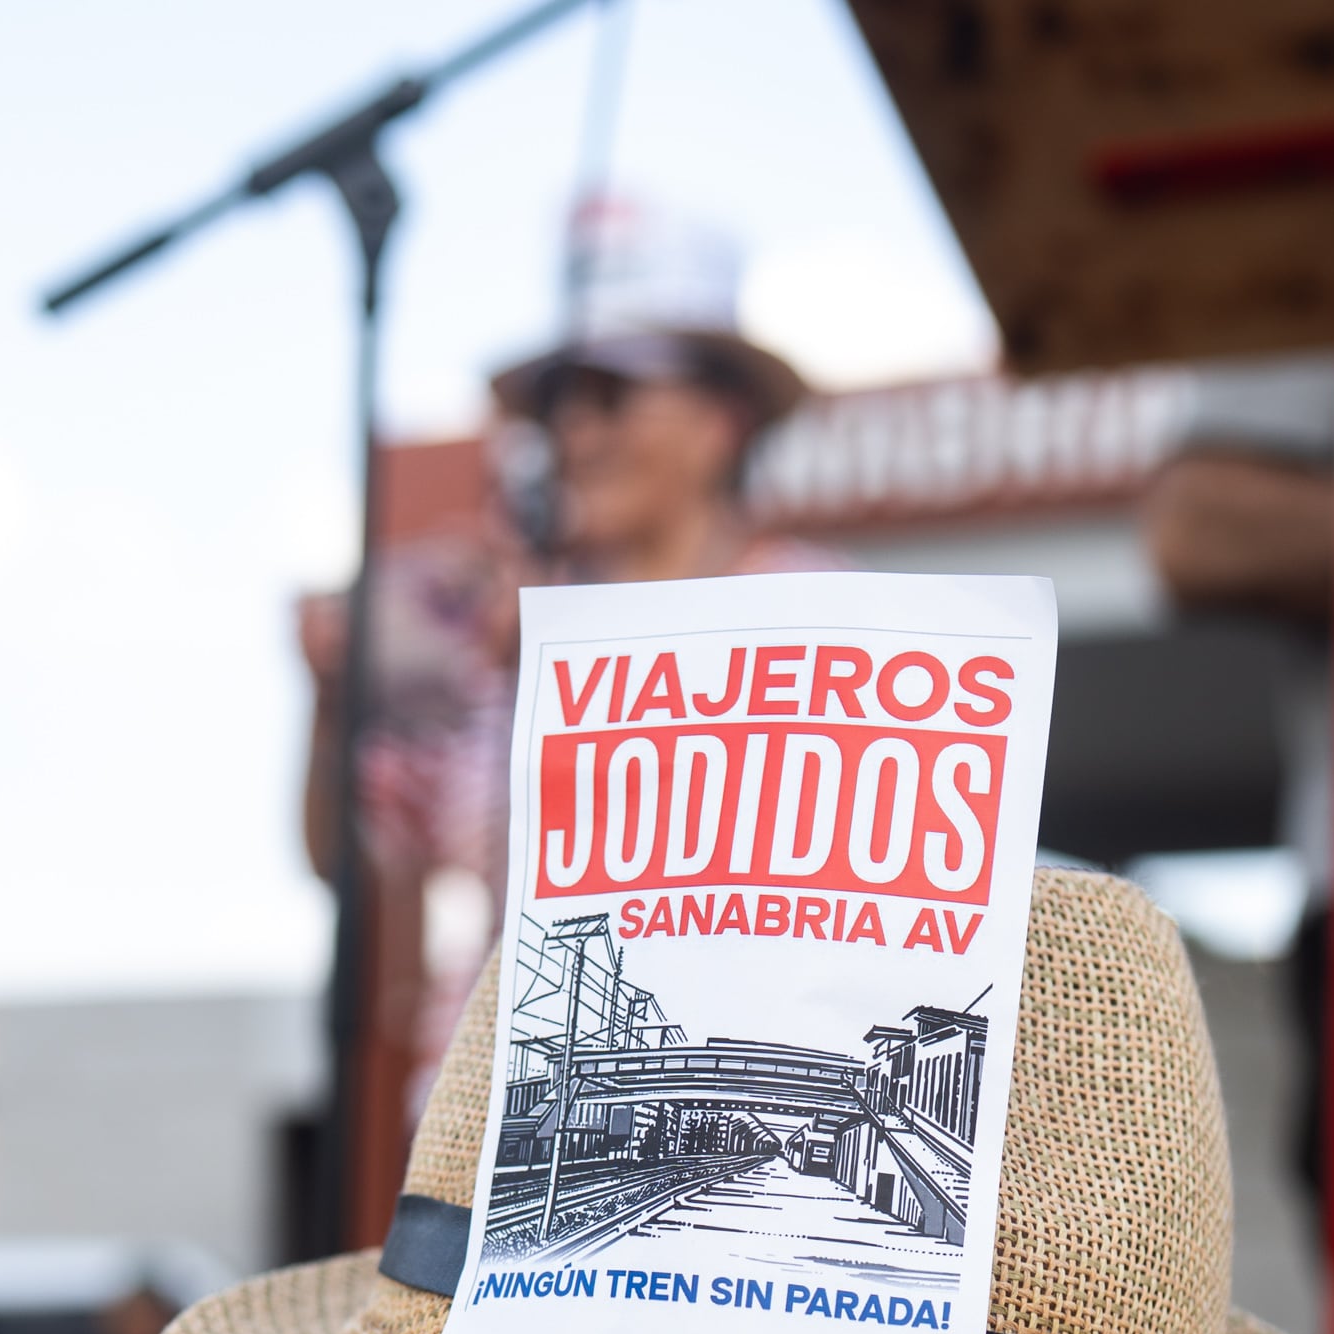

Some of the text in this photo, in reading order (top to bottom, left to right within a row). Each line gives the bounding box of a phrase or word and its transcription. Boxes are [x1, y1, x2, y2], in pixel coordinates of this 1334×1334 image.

[553, 645, 1015, 727] VIAJEROS
[545, 733, 992, 893] JODIDOS
[618, 893, 984, 955] SANABRIA AV
[472, 1263, 952, 1331] ¡NINGÚN TREN SIN PARADA!
